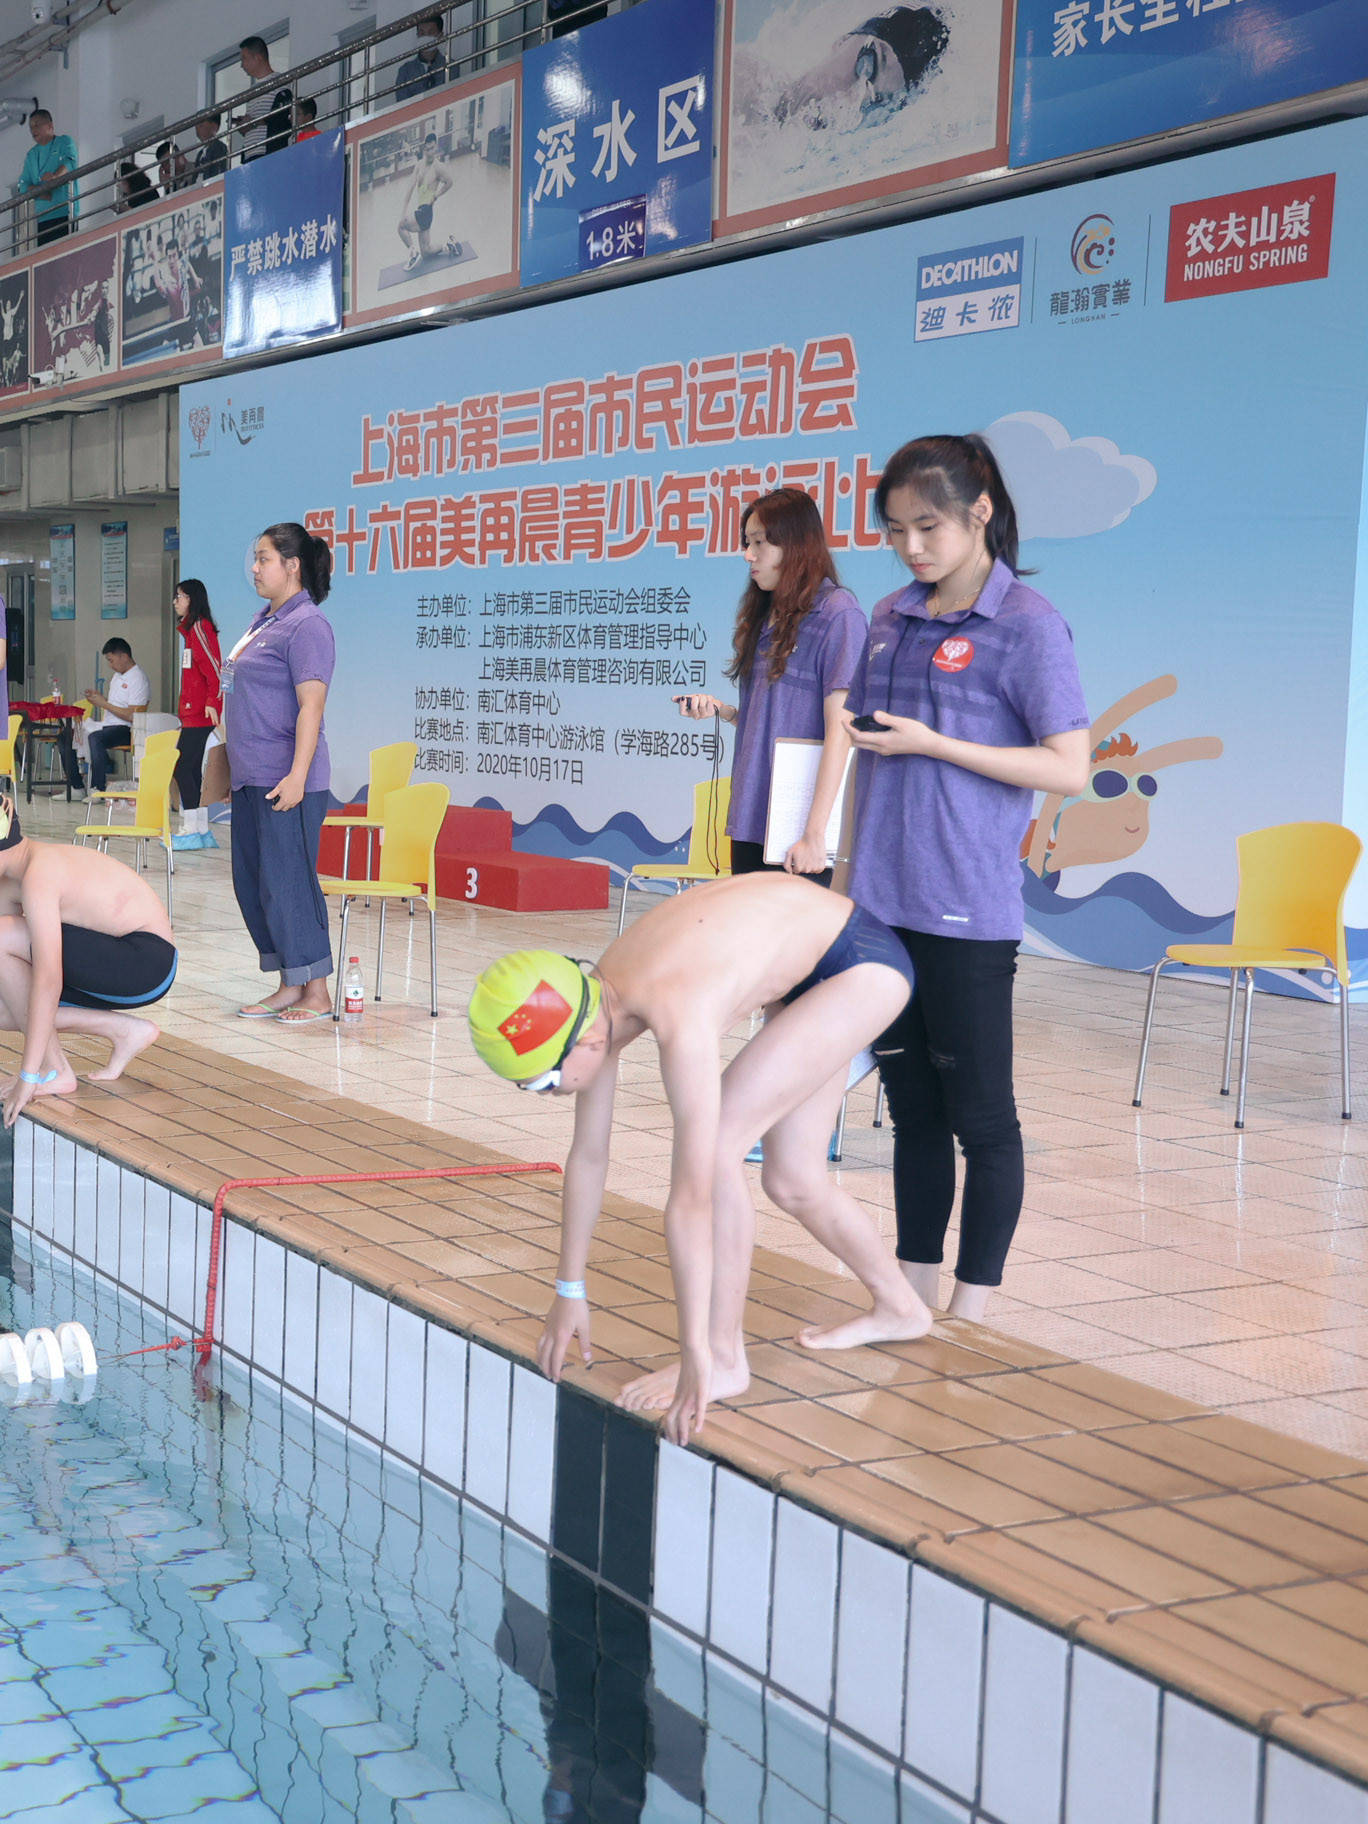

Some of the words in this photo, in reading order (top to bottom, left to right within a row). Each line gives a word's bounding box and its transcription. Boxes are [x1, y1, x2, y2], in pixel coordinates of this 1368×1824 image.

[533, 73, 705, 202] 深水区
[229, 213, 337, 281] 严禁跳水潜水
[586, 220, 637, 261] 1.8米
[1185, 199, 1311, 258] 农夫山泉
[921, 249, 1018, 290] DECATHLON
[1184, 254, 1244, 282] NONGFU
[1249, 243, 1308, 271] SPRING
[919, 294, 1016, 333] 迪卡侬
[351, 333, 859, 488] 上海市第三届市民运动会
[303, 454, 894, 577] 十六届美再晨青少年游比
[478, 656, 706, 687] 上海美再晨体育管理咨询有限公司
[465, 867, 478, 899] 3
